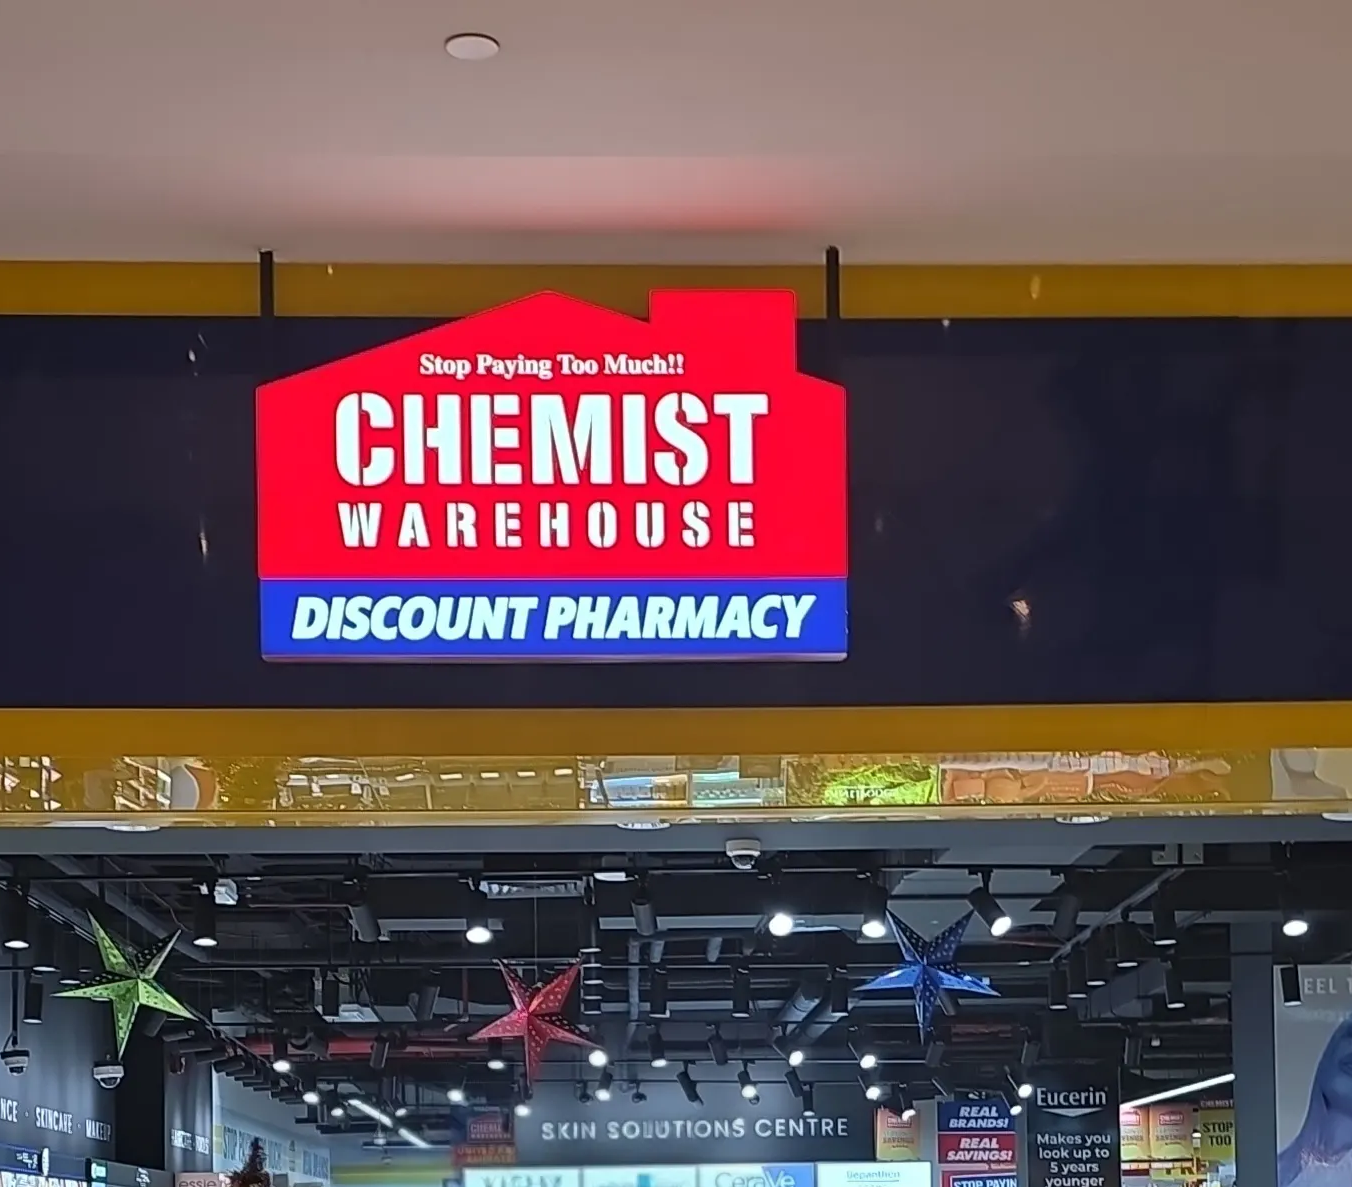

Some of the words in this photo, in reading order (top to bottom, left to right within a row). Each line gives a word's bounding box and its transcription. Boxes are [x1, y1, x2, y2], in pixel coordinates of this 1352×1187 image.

[420, 353, 472, 380] Stop
[477, 353, 553, 380] Paying
[557, 355, 599, 376] Too
[604, 354, 684, 376] Much!!
[335, 392, 768, 487] CHEMIST
[337, 501, 755, 549] WAREHOUSE
[291, 595, 538, 641] DISCOUNT
[544, 594, 817, 641] PHARMACY
[1304, 977, 1337, 994] EEL
[1037, 1087, 1107, 1106] Eucerin
[959, 1106, 999, 1117] REAL
[35, 1106, 73, 1135] SKINCARE
[949, 1117, 1009, 1128] BRANDS!
[1202, 1121, 1233, 1132] STOP
[541, 1121, 596, 1140] SKIN
[607, 1118, 744, 1140] SOLUTIONS
[755, 1117, 848, 1138] CENTRE
[959, 1137, 1000, 1149] REAL
[1037, 1133, 1082, 1144] Makes
[1085, 1135, 1111, 1147] you
[1209, 1135, 1231, 1147] TOO
[947, 1150, 1013, 1161] SAVINGS!
[1039, 1148, 1069, 1158] look
[1073, 1150, 1092, 1161] up
[1095, 1149, 1109, 1158] to
[1050, 1161, 1059, 1173] 5
[1061, 1163, 1100, 1175] years
